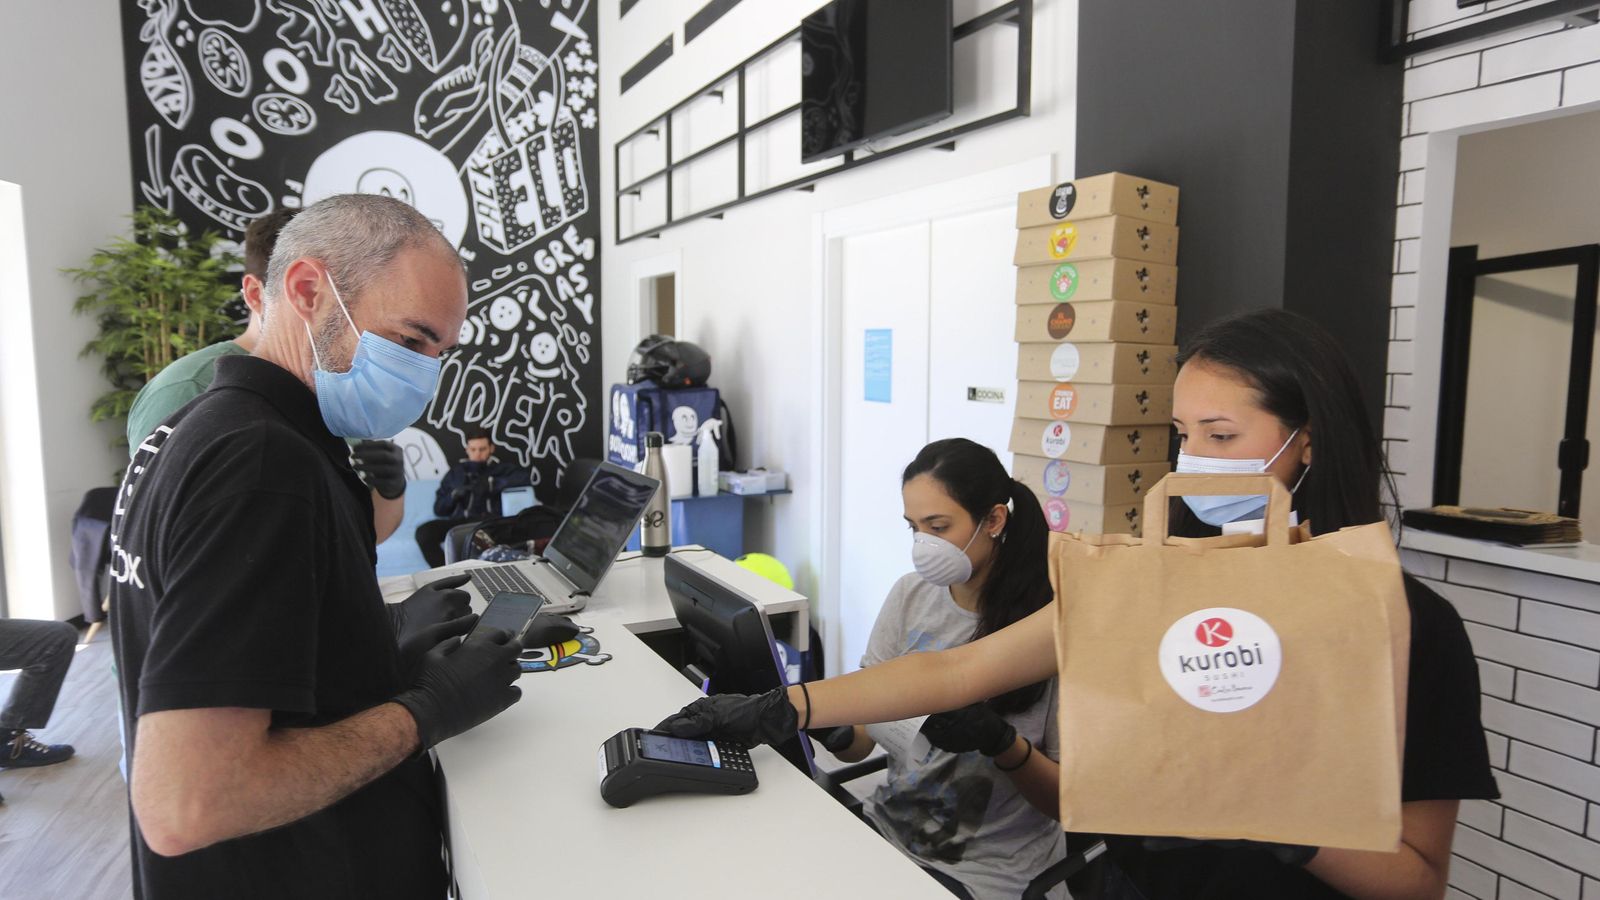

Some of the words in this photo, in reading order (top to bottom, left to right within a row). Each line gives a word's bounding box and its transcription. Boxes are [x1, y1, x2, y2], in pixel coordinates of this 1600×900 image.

[178, 173, 248, 228] CRUNC
[976, 390, 1004, 401] COCINA
[1053, 396, 1072, 410] EAT
[1178, 642, 1263, 673] kurobi
